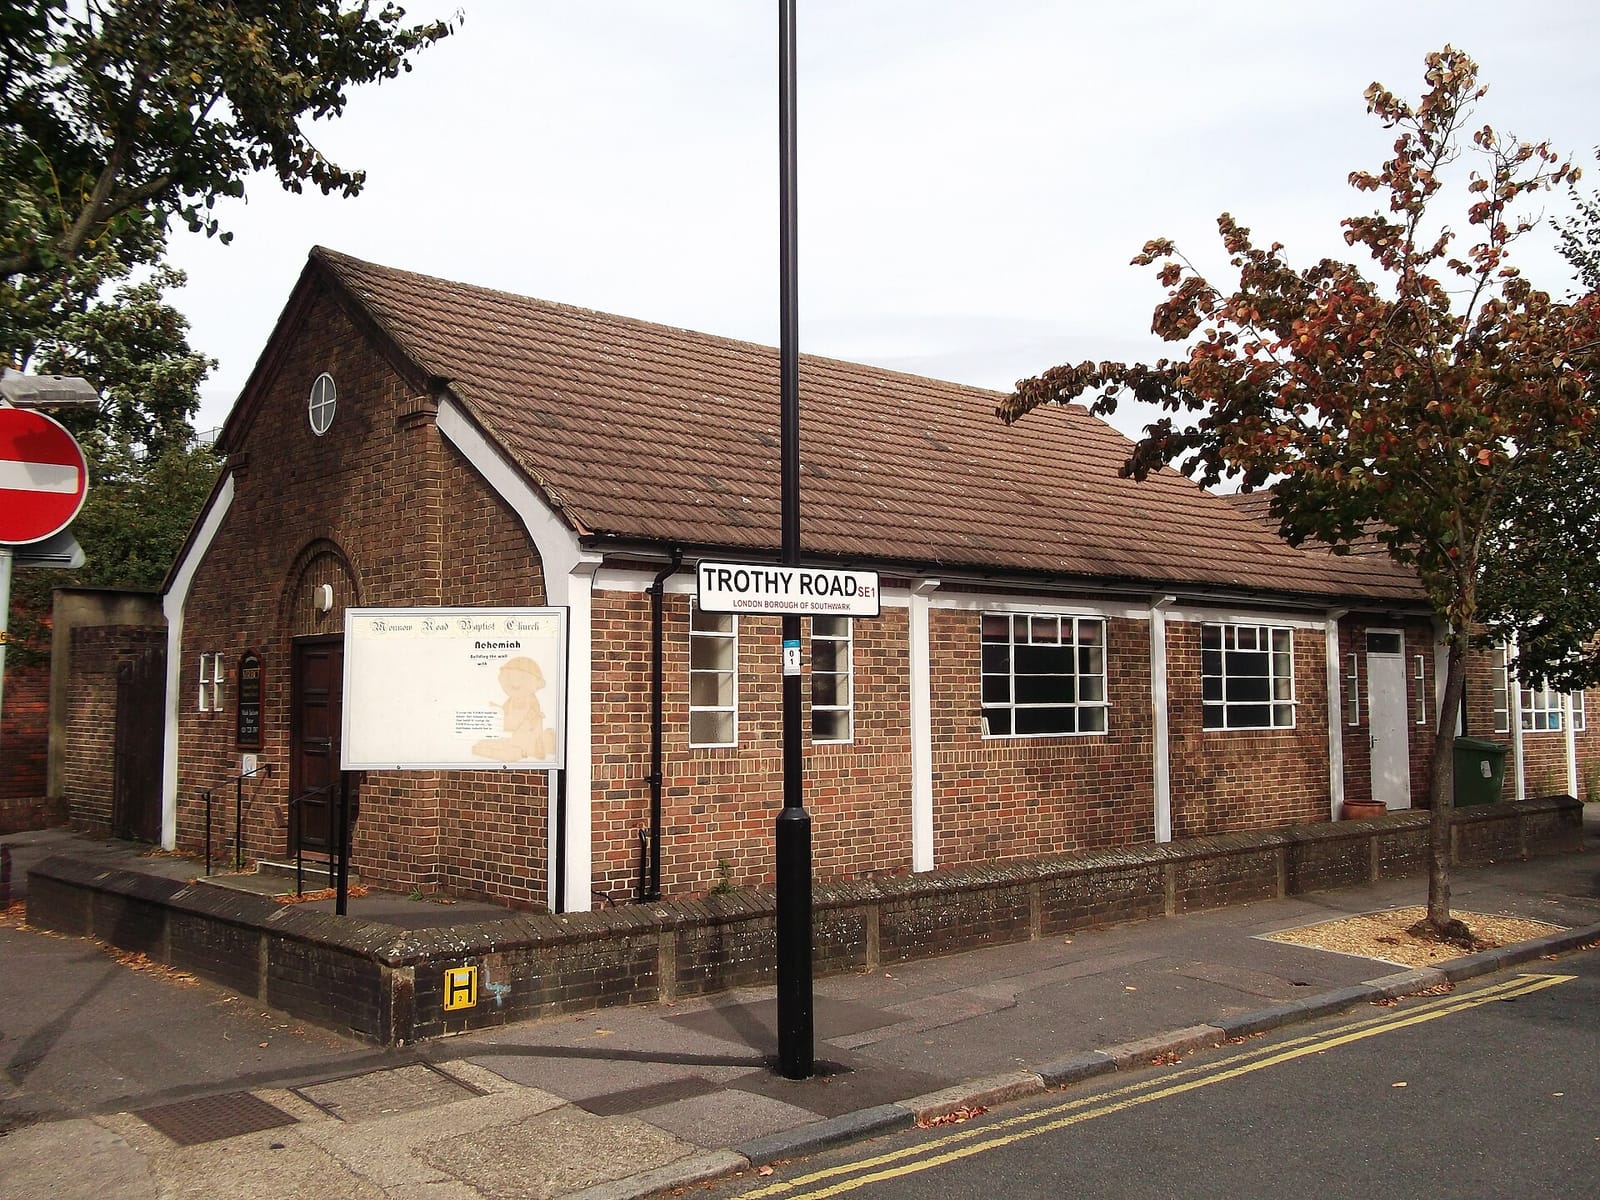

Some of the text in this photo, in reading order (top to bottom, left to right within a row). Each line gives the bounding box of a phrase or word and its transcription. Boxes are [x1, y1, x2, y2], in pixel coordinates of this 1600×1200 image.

[703, 568, 875, 598] TROTHY ROAD SE1
[733, 599, 851, 611] LONDON BOROUGH OF SOUTHWARK
[420, 617, 449, 634] Road
[457, 617, 495, 633] Baptist
[504, 617, 540, 632] Church
[474, 640, 521, 649] Nehemiah
[450, 970, 472, 1005] H
